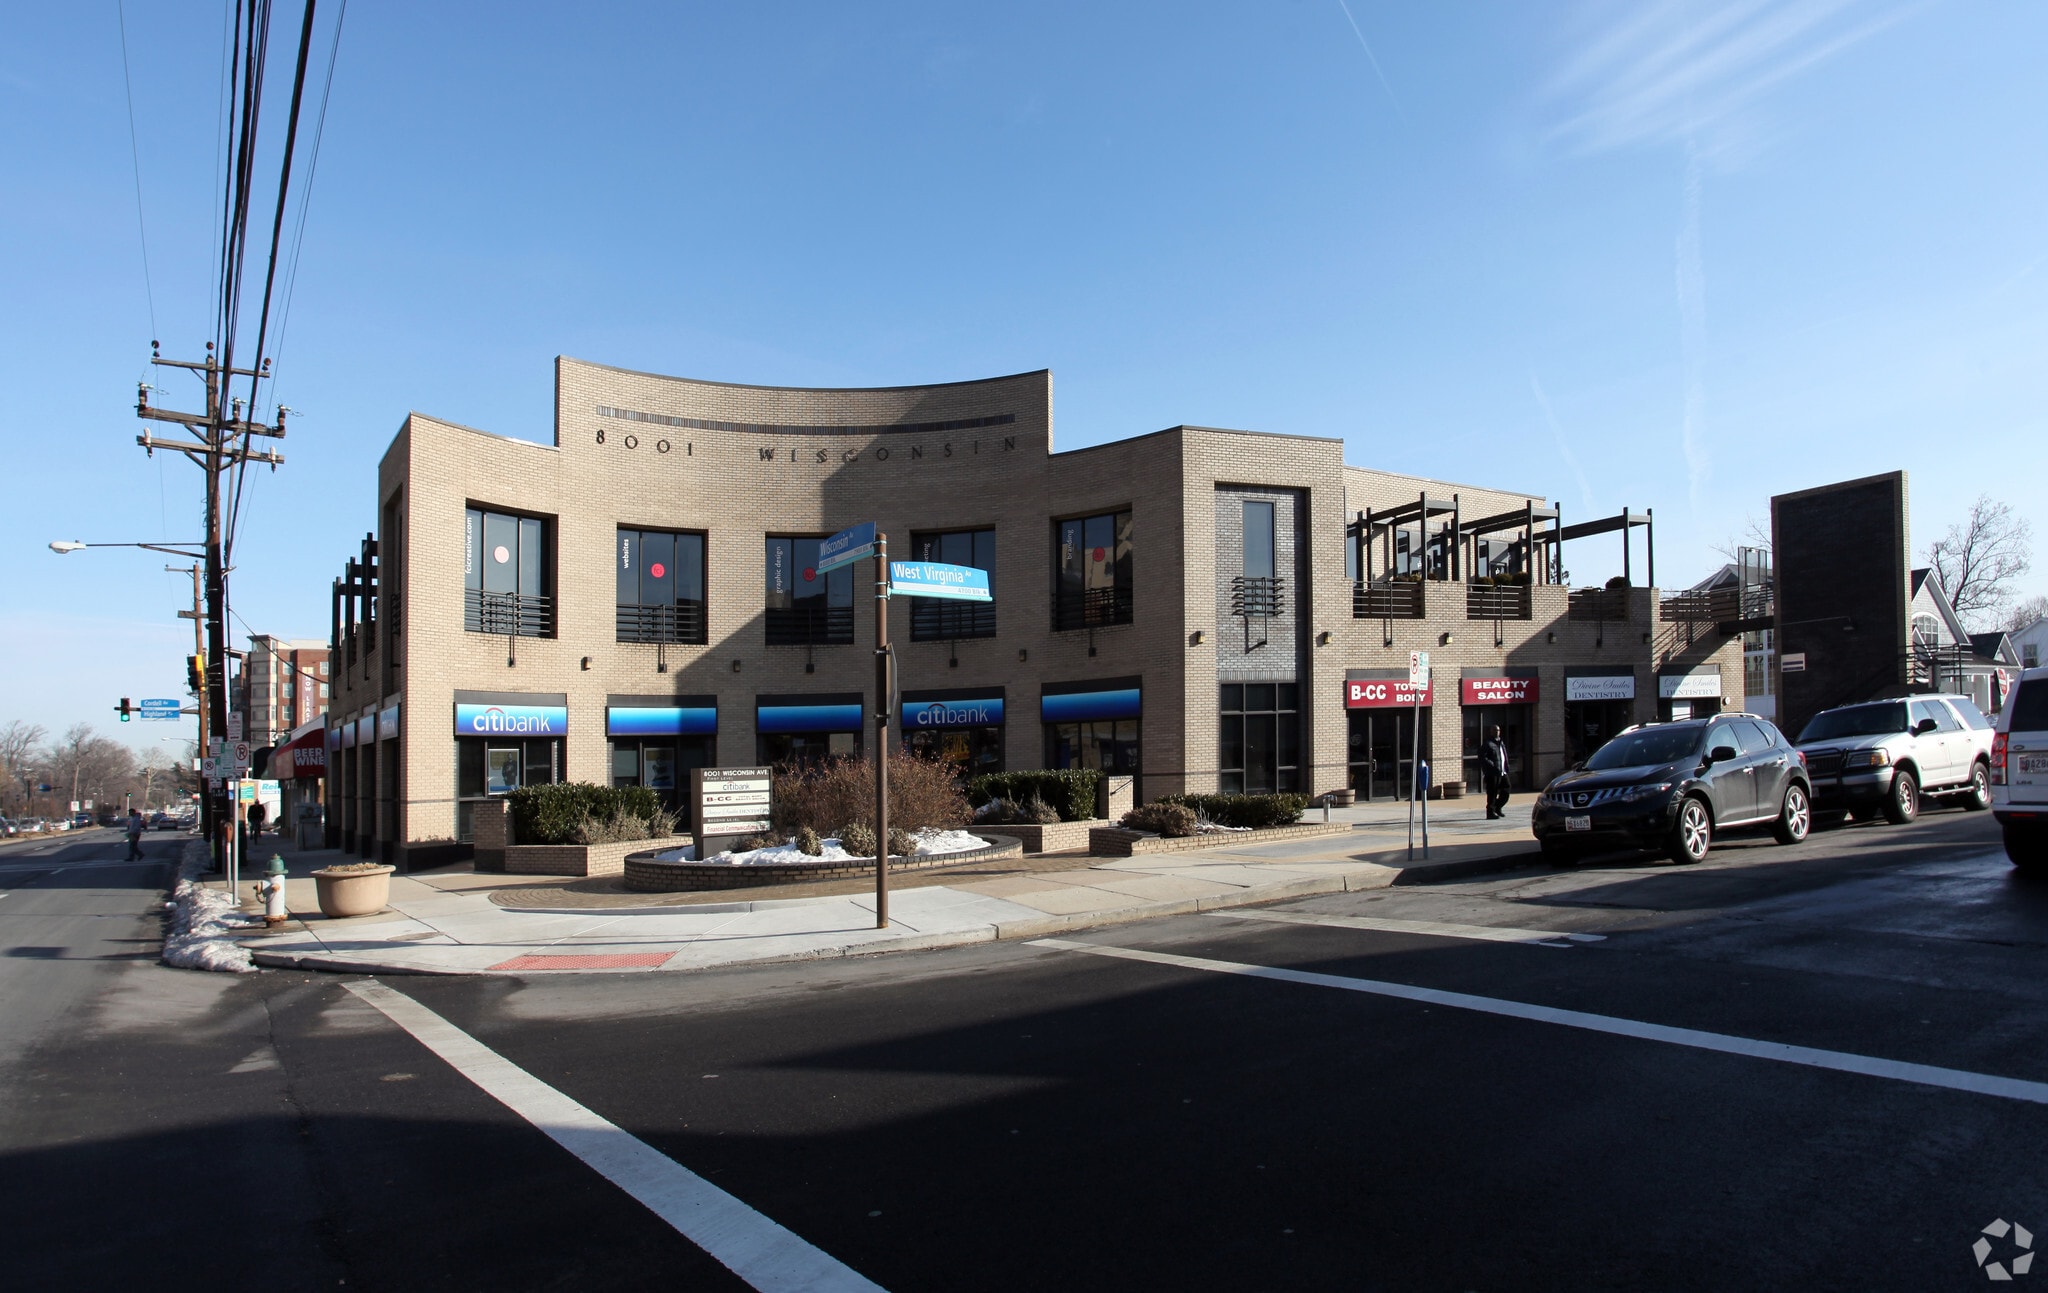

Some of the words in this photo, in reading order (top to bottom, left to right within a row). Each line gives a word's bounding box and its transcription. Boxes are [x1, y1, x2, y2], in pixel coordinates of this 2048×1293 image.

[596, 429, 692, 457] 8001
[758, 437, 1015, 463] WISCONSIN
[464, 517, 473, 574] fcicreative.com
[820, 534, 849, 557] Wisconsin
[776, 546, 784, 570] design
[776, 570, 784, 594] graphic
[893, 563, 921, 580] West
[925, 567, 964, 585] Virginia
[1472, 681, 1530, 690] BEAUTY
[1571, 679, 1601, 690] Divine
[1603, 677, 1631, 689] Smiles
[1693, 677, 1717, 688] Smiles
[1351, 684, 1387, 700] B-CC
[1477, 691, 1525, 700] SALON
[1574, 691, 1627, 699] DENTISTRY
[473, 710, 551, 732] citibank
[917, 704, 988, 725] citibank
[294, 747, 323, 757] BEER
[296, 756, 325, 766] WINE
[723, 782, 750, 791] citibank
